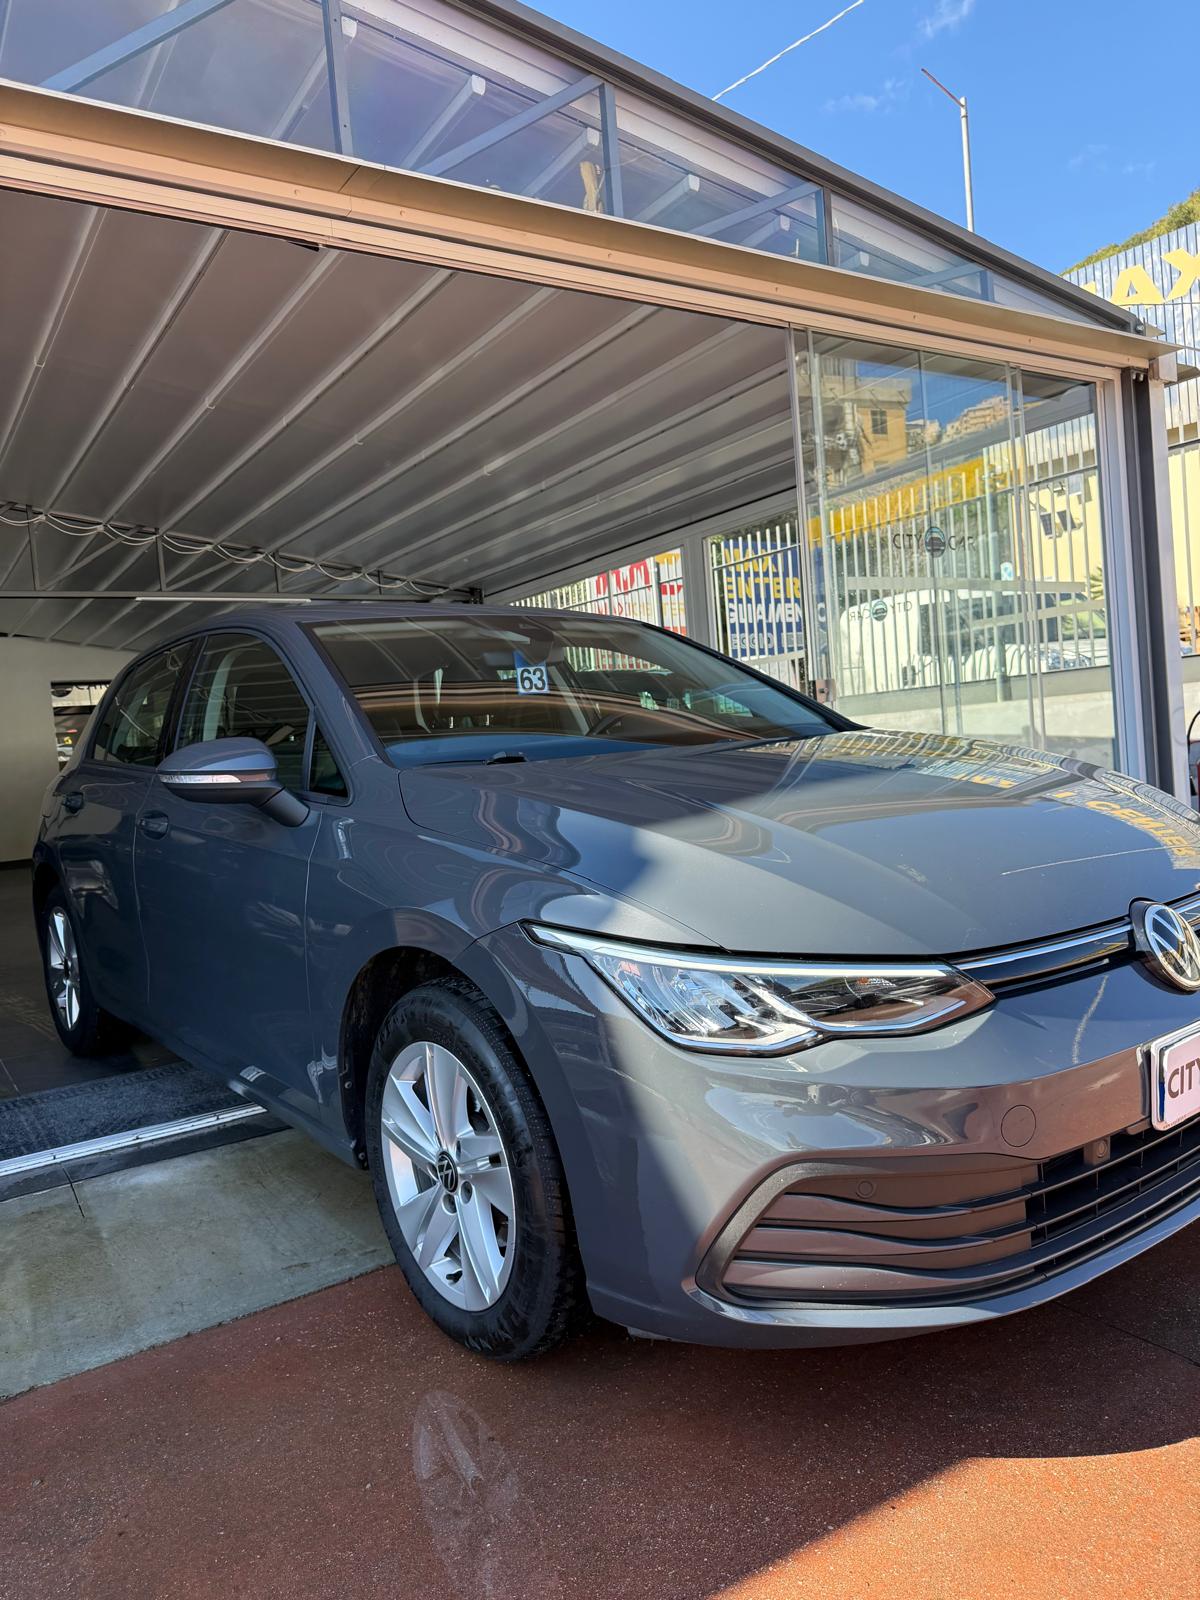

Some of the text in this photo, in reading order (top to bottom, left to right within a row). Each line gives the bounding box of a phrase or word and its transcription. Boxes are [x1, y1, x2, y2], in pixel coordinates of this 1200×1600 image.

[1080, 247, 1200, 310] AX
[893, 533, 976, 551] CITY CAR
[520, 667, 546, 691] 63
